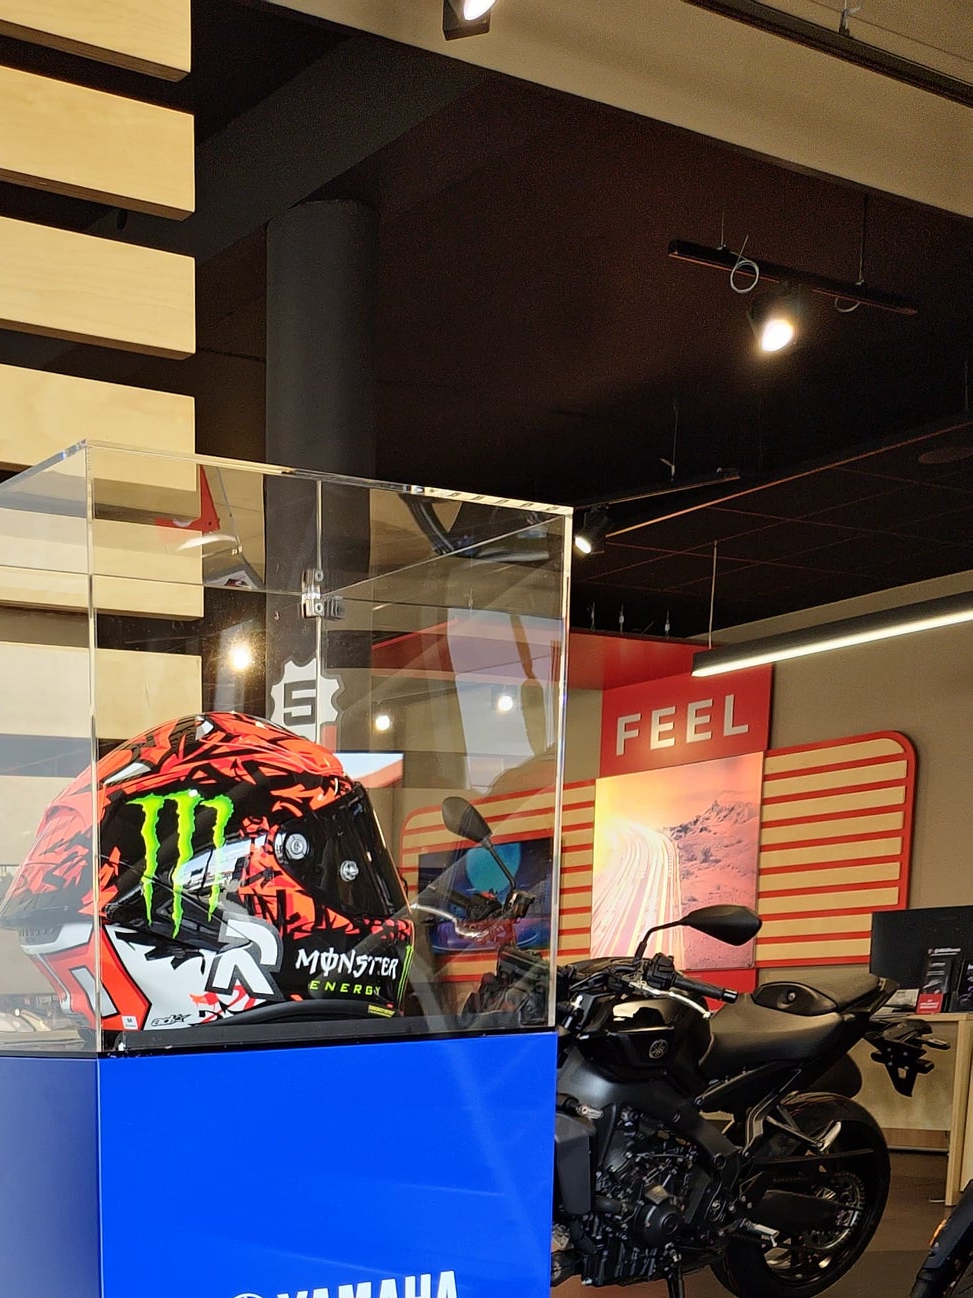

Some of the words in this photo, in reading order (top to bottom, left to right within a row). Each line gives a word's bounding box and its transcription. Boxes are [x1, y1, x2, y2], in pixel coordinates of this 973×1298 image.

[614, 694, 749, 755] FEEL
[295, 947, 399, 980] MONSTER
[309, 980, 381, 996] ENERGY
